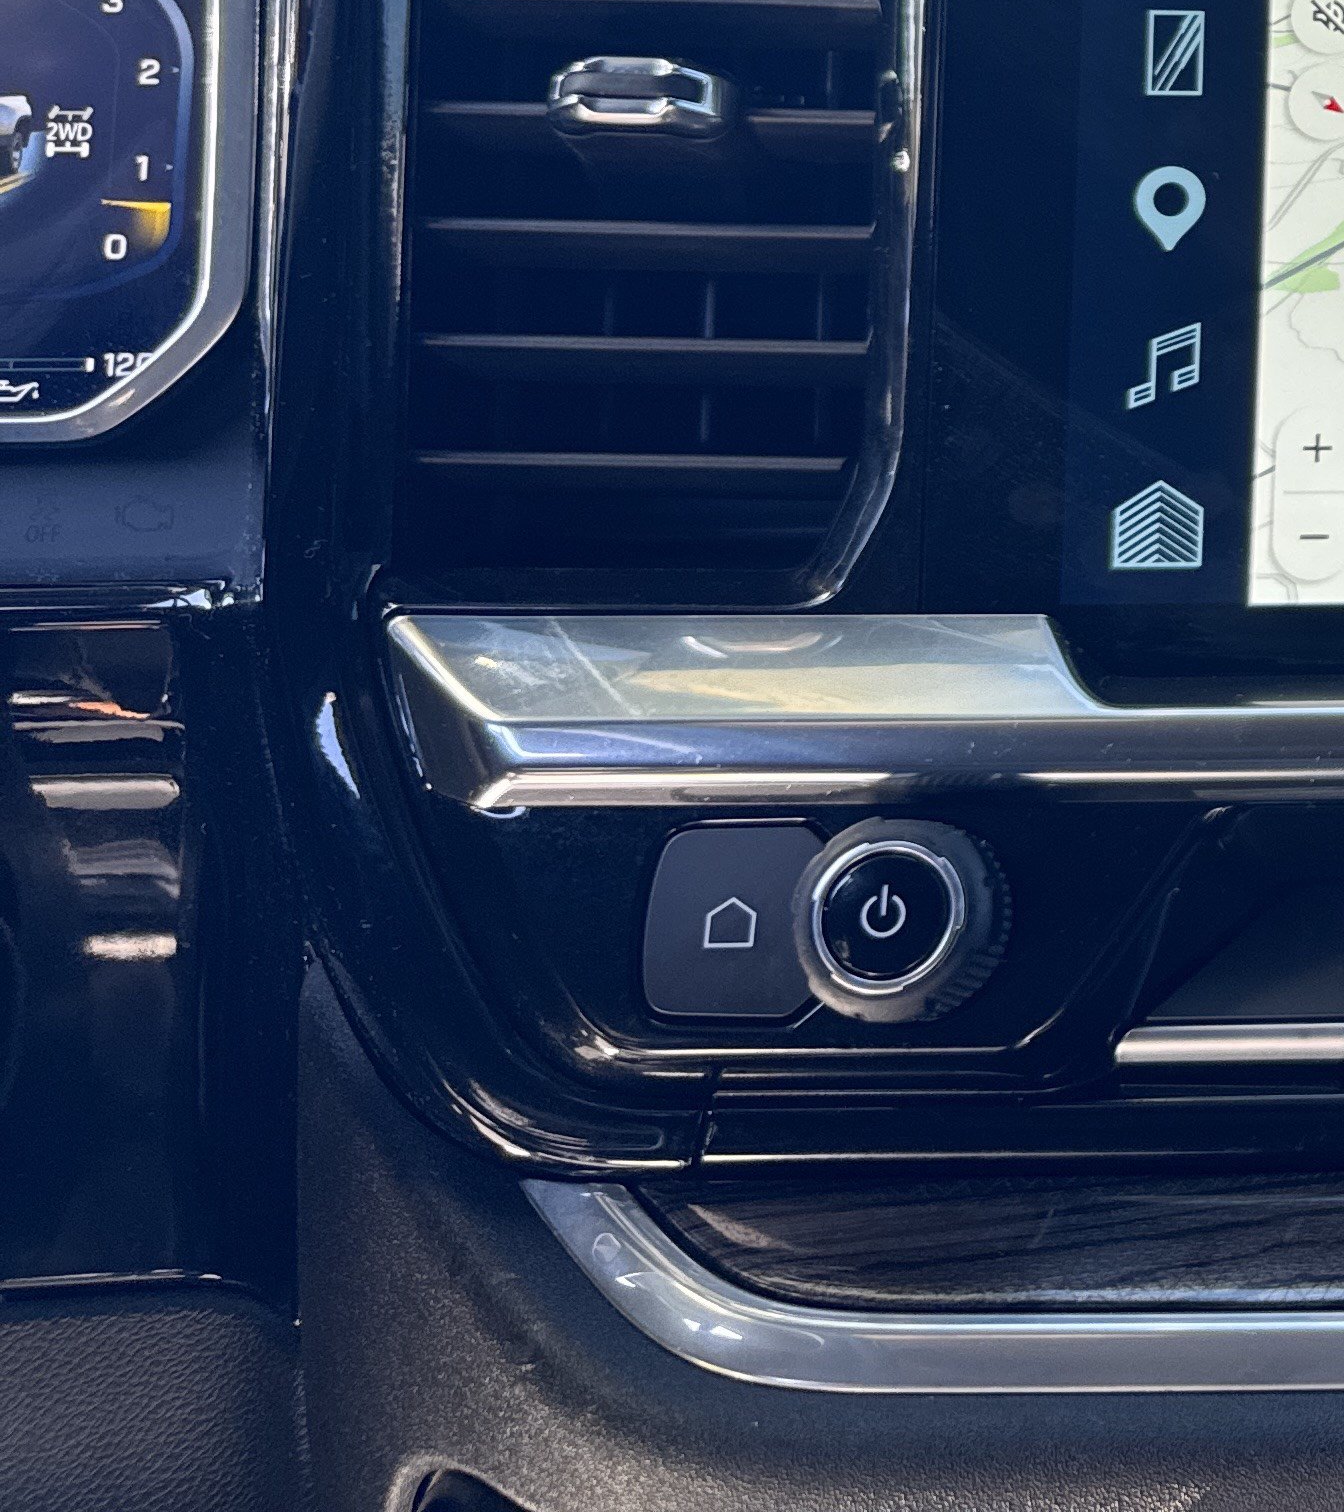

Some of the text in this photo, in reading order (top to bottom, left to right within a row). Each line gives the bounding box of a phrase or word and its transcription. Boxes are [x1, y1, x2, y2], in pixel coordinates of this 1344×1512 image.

[138, 59, 161, 84] 2
[46, 121, 92, 142] 2WD
[135, 155, 149, 179] 1
[104, 235, 127, 260] 0
